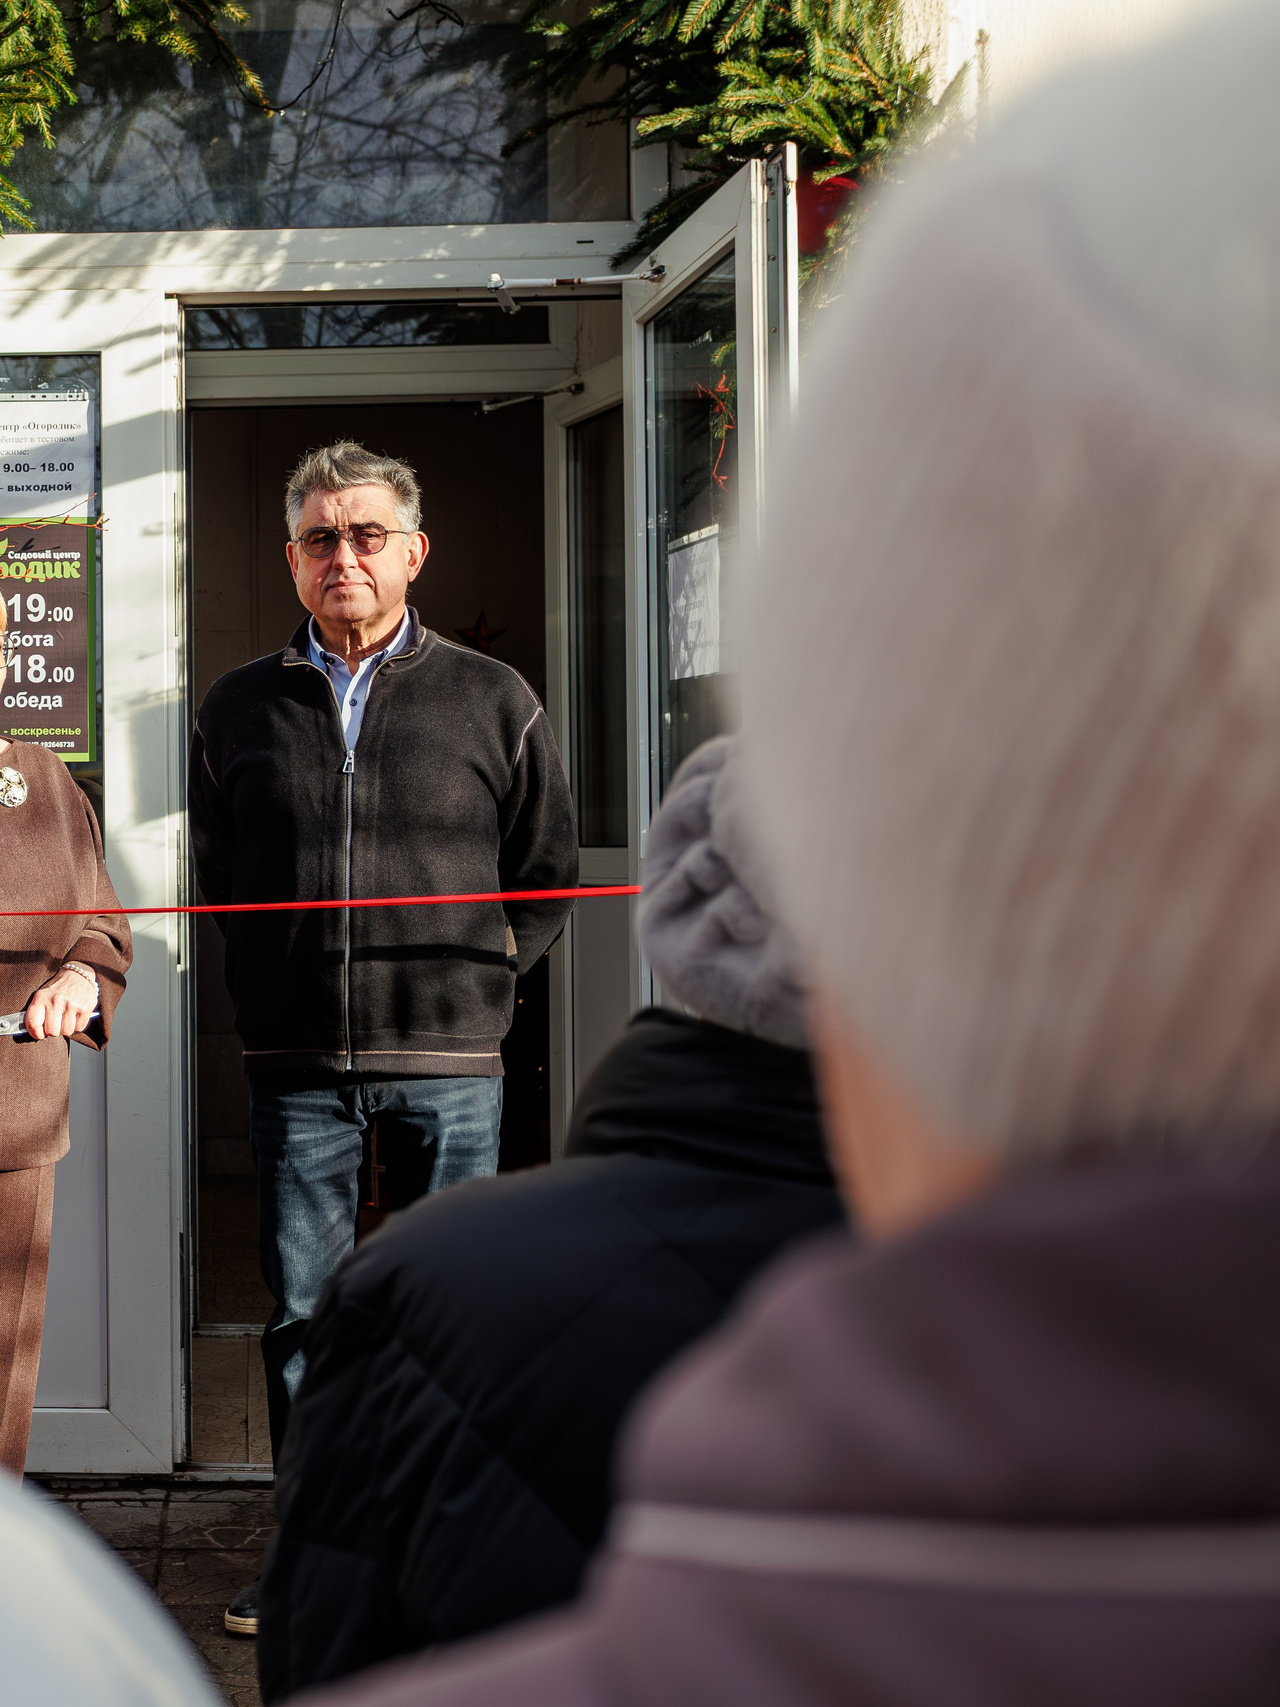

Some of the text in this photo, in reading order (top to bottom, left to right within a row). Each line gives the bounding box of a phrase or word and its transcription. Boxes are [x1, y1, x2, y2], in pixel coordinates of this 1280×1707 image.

[22, 421, 81, 432] «Огородик»
[37, 435, 75, 443] тестовом
[40, 462, 74, 472] 18.00
[7, 482, 72, 493] выходной
[8, 550, 81, 560] Садовый центр
[7, 653, 75, 684] 18.00
[3, 692, 63, 710] обеда
[10, 727, 81, 737] воскресенье
